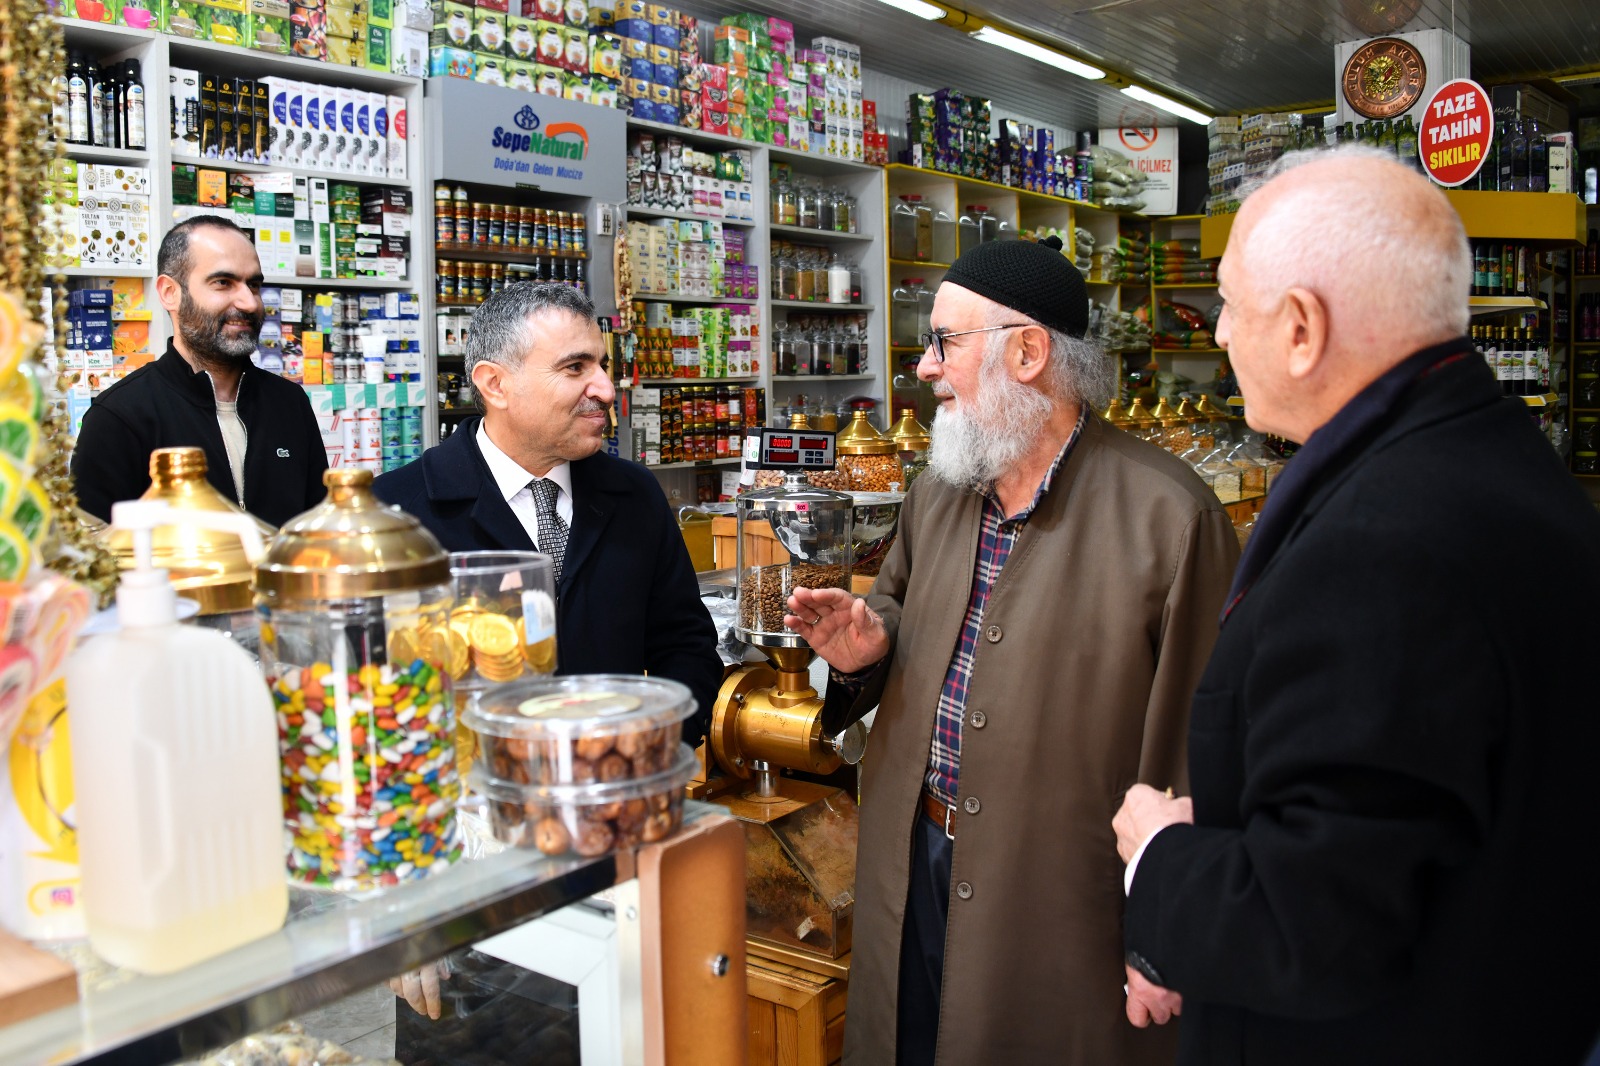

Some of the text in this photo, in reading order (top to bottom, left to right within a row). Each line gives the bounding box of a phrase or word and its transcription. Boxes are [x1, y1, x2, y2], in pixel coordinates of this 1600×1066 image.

[1388, 44, 1419, 85] AKTAR
[1433, 91, 1476, 119] TAZE
[1428, 113, 1482, 145] TAHİN
[493, 157, 583, 180] Doğa'dan Gelen Mucize
[1429, 142, 1481, 170] SIKILIR
